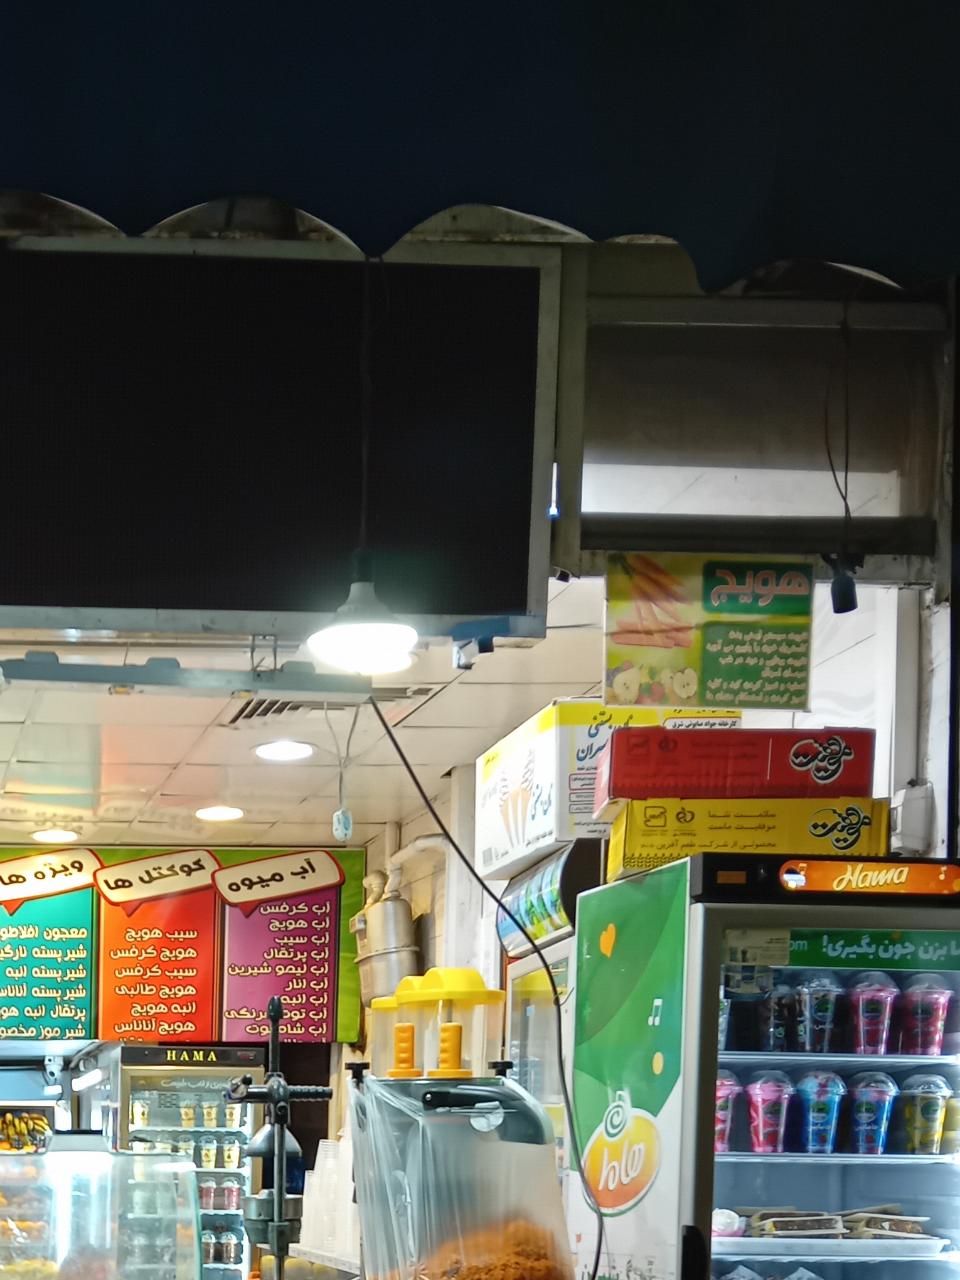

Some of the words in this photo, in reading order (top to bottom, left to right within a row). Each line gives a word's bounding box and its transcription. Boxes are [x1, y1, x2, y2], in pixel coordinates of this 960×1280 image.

[711, 569, 809, 606] هویج
[34, 860, 84, 880] ویژه
[138, 858, 206, 884] کوکتل
[290, 858, 316, 879] آب
[103, 878, 133, 890] ها
[228, 872, 284, 892] میوه
[833, 864, 909, 891] Hama
[260, 902, 308, 915] کرفس
[312, 902, 330, 915] آب
[269, 917, 308, 931] هویج
[311, 916, 330, 930] آب
[43, 926, 88, 941] معجون
[125, 927, 163, 942] هویج
[165, 929, 198, 942] سیب
[274, 935, 308, 946] سیب
[311, 932, 329, 946] آب
[32, 946, 62, 963] پسته
[64, 943, 87, 961] شیر
[110, 944, 157, 960] کرفس
[160, 947, 198, 961] هویج
[263, 947, 308, 962] پرتقال
[310, 947, 329, 961] آب
[822, 934, 876, 960] بگیری!
[878, 939, 916, 960] جون
[5, 965, 27, 980] انبه
[32, 965, 62, 983] پسته
[64, 963, 87, 980] شیر
[115, 963, 162, 979] کرفس
[165, 967, 197, 980] سیب
[228, 961, 272, 976] شیرین
[275, 963, 307, 976] لیمو
[310, 962, 329, 976] آب
[63, 983, 87, 1000] شیر
[115, 982, 157, 998] طالبی
[159, 984, 197, 999] هویج
[285, 979, 307, 991] انار
[309, 977, 328, 992] آب
[31, 985, 61, 1002] پسته
[280, 993, 306, 1006] انبه
[309, 992, 328, 1007] آب
[24, 1005, 46, 1019] انبه
[50, 1004, 86, 1022] پرتقال
[131, 1003, 168, 1017] هویج
[171, 1001, 196, 1016] انبه
[309, 1008, 328, 1022] آب
[39, 1025, 61, 1039] موز
[63, 1023, 86, 1039] شیر
[114, 1018, 156, 1033] آناناس
[158, 1020, 196, 1035] هویج
[245, 1024, 272, 1036] وت
[308, 1023, 327, 1037] آب
[167, 1050, 217, 1062] HAMA
